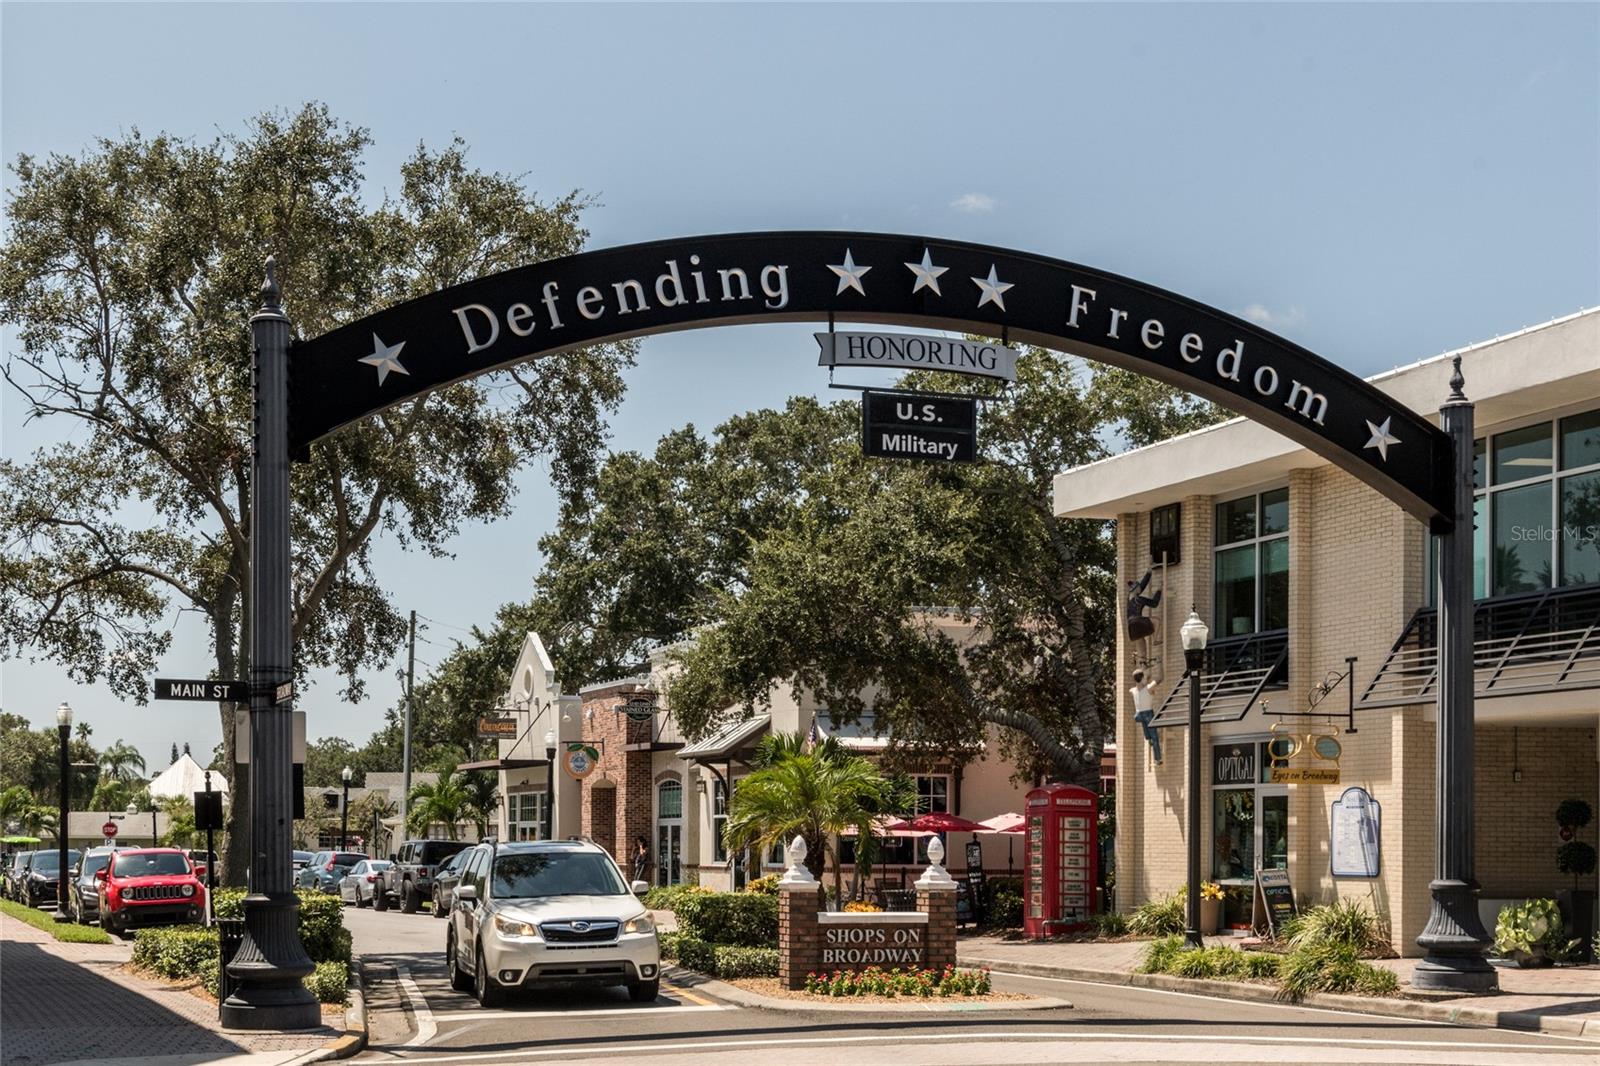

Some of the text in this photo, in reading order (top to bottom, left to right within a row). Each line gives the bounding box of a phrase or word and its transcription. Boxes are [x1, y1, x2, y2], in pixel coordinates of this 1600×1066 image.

[452, 254, 1329, 427] Defending Freedom
[846, 335, 998, 370] HONORING
[896, 402, 944, 423] U.S.
[881, 433, 958, 461] Military
[170, 683, 231, 699] MAIN ST
[1218, 755, 1256, 781] OPTICAL
[1272, 770, 1339, 784] Eyes on Broadway
[1266, 888, 1291, 896] OPTICAL
[826, 928, 920, 944] SHOPS ON
[823, 948, 924, 963] BROADWAY
